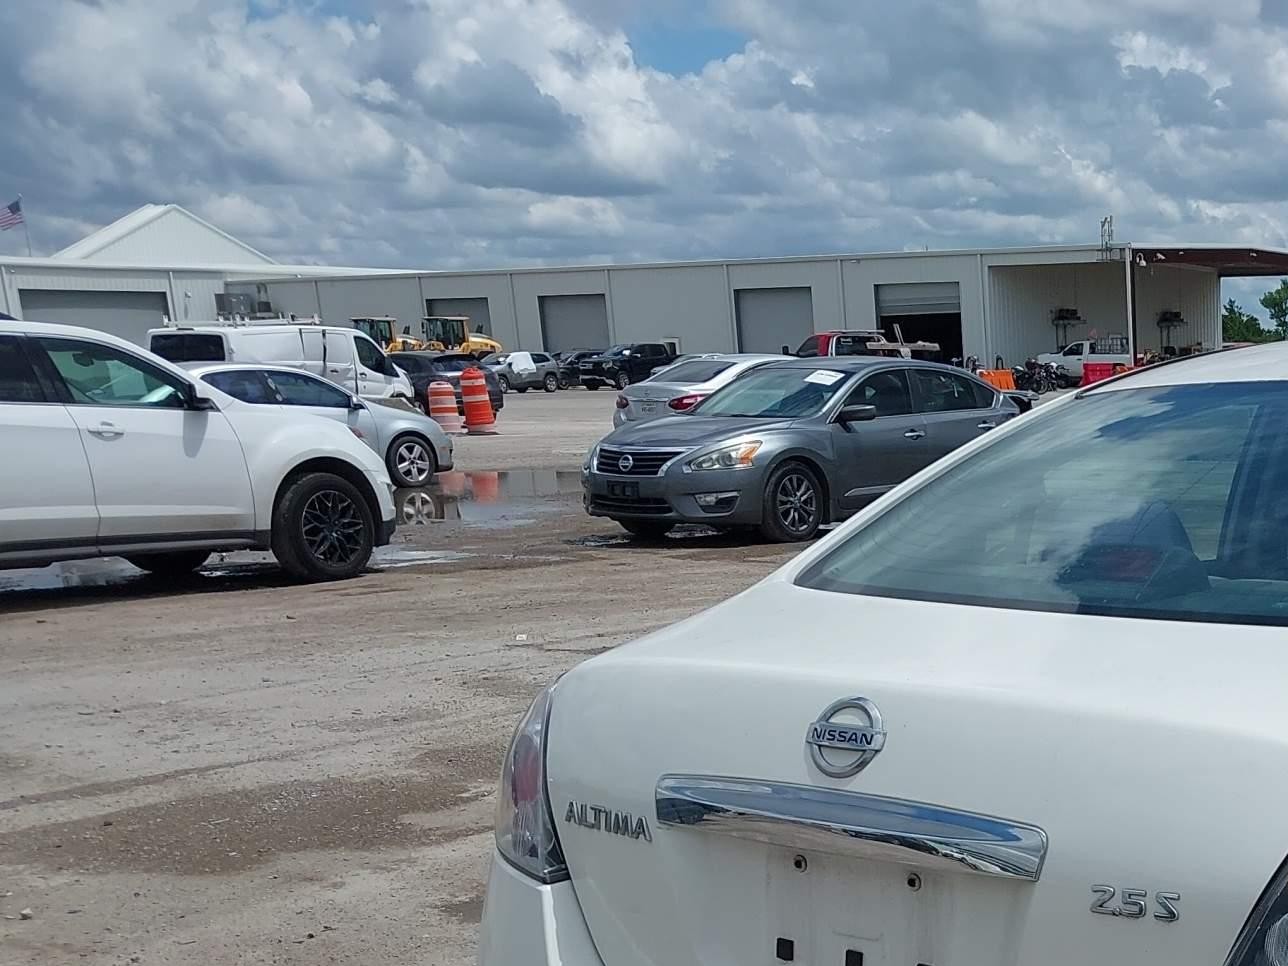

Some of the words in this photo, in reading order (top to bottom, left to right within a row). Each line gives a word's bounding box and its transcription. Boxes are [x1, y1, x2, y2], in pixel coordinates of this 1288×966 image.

[811, 727, 874, 746] NISSAN
[565, 800, 653, 842] ALTIMA
[1154, 892, 1180, 921] S
